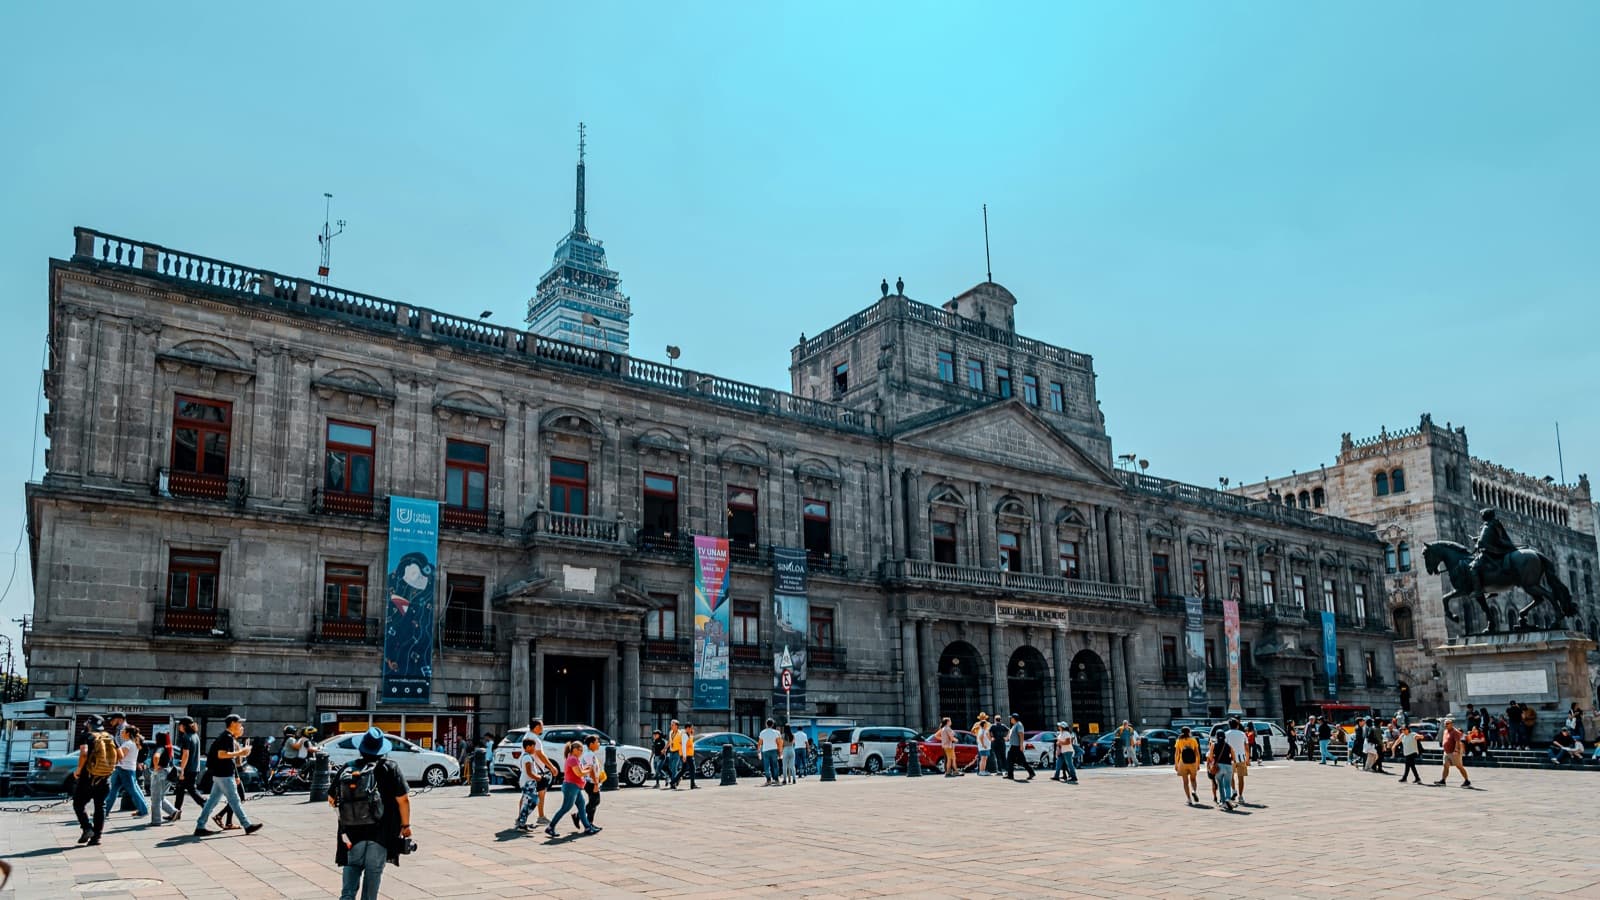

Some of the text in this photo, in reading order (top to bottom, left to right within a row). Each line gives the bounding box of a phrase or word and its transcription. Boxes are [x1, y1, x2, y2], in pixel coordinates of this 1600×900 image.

[563, 287, 627, 310] LATINOAMERICANA
[698, 547, 726, 557] TV UNAM
